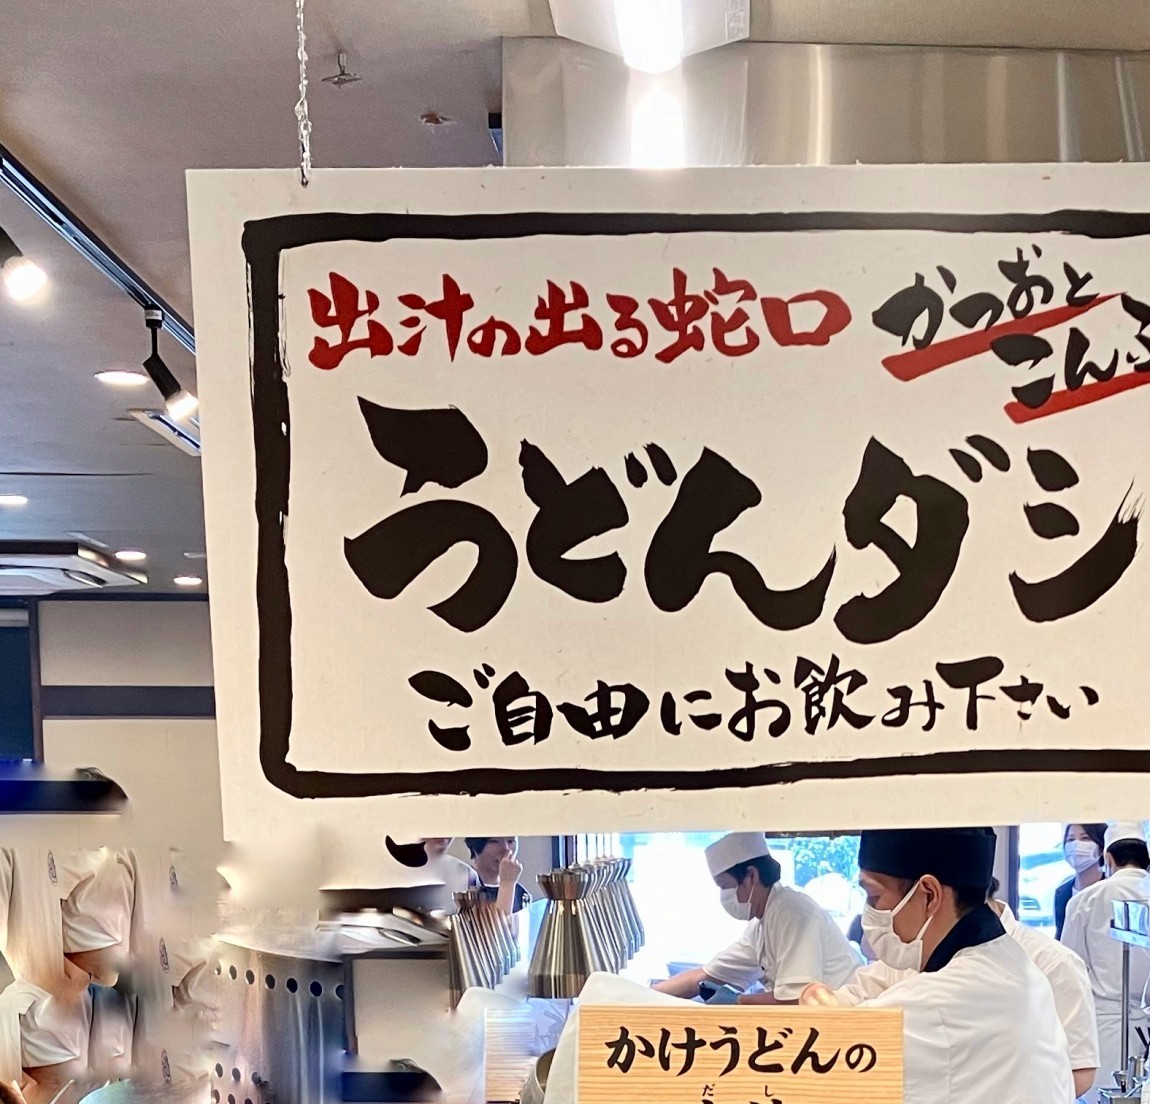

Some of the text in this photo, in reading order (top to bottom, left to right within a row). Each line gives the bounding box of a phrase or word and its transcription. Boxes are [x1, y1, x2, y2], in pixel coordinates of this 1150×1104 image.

[307, 267, 852, 371] 出汁の出る蛇口
[872, 244, 1100, 349] かつおと
[344, 396, 1145, 644] うどんダシ
[409, 655, 1100, 748] ご自由にお飲み下さい
[604, 1025, 877, 1077] かけうどんの
